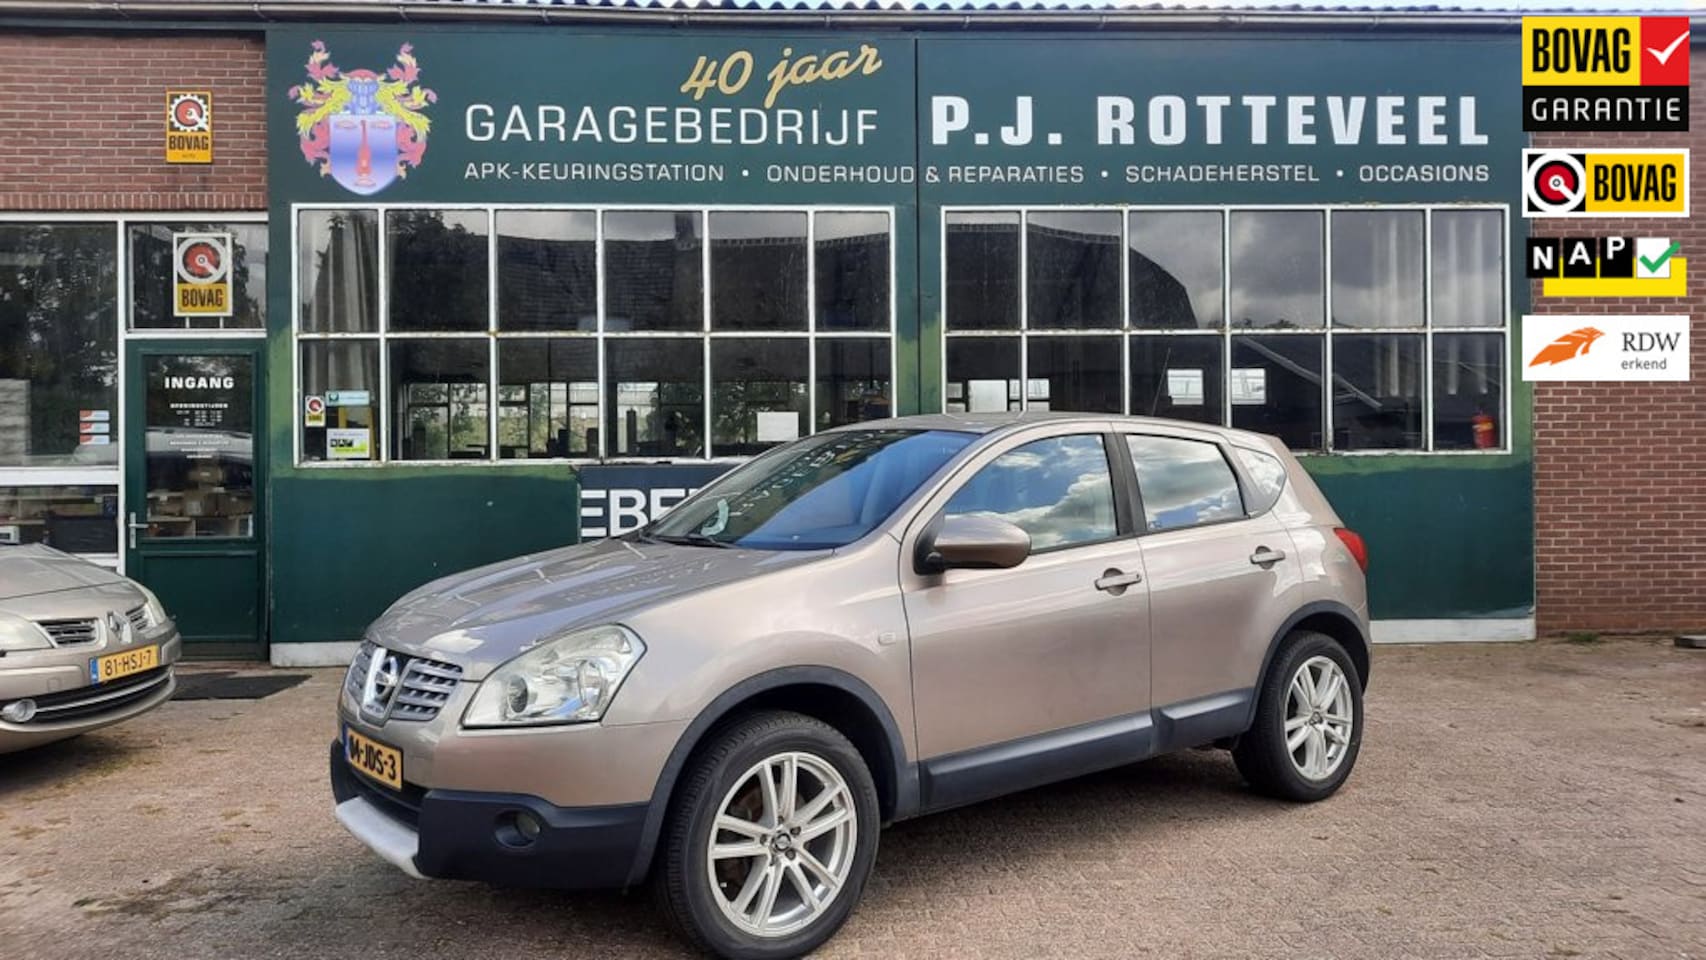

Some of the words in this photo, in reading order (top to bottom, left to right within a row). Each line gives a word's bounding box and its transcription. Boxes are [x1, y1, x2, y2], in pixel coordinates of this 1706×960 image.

[680, 50, 754, 101] 40
[764, 44, 883, 109] jaar
[465, 103, 878, 146] GARAGEBEDRIJF
[931, 96, 1062, 146] P.J.
[1097, 95, 1489, 146] ROTTEVEEL
[168, 134, 209, 151] BOVAG
[464, 162, 724, 182] APK-KEURINGSTATION
[766, 164, 915, 184] ONDERHOUD
[925, 165, 941, 183] &
[948, 165, 1085, 183] REPARATIES
[1125, 164, 1320, 183] SCHADEHERSTEL
[1359, 164, 1490, 183] OCCASIONS
[181, 288, 224, 307] BOVAG
[164, 376, 234, 389] INGANG
[580, 488, 701, 537] EBE
[104, 649, 152, 676] 81-HSJ-7
